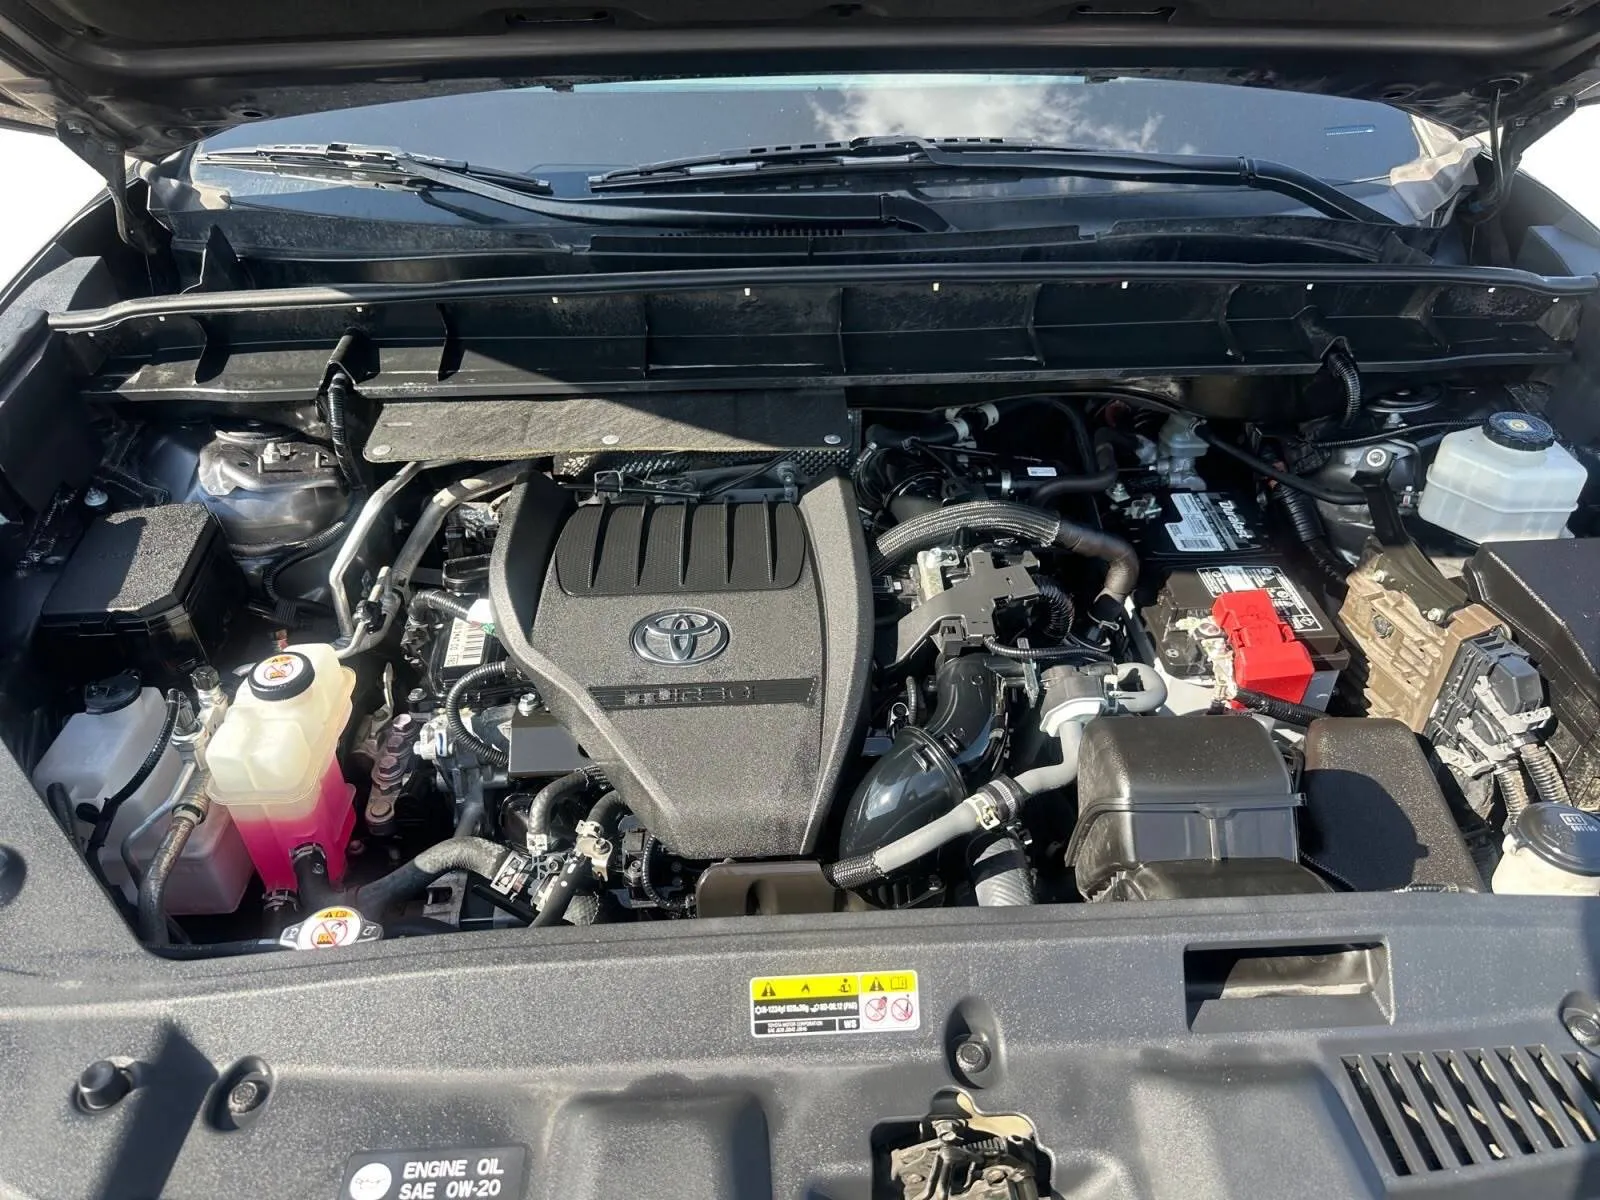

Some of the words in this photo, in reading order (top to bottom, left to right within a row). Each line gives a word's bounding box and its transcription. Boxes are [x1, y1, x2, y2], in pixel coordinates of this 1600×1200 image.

[1218, 500, 1253, 538] Duralast
[843, 1020, 857, 1029] WS
[403, 1160, 468, 1180] ENGINE
[477, 1158, 504, 1175] OIL
[399, 1182, 436, 1200] SAE
[446, 1179, 501, 1198] 0W-20
